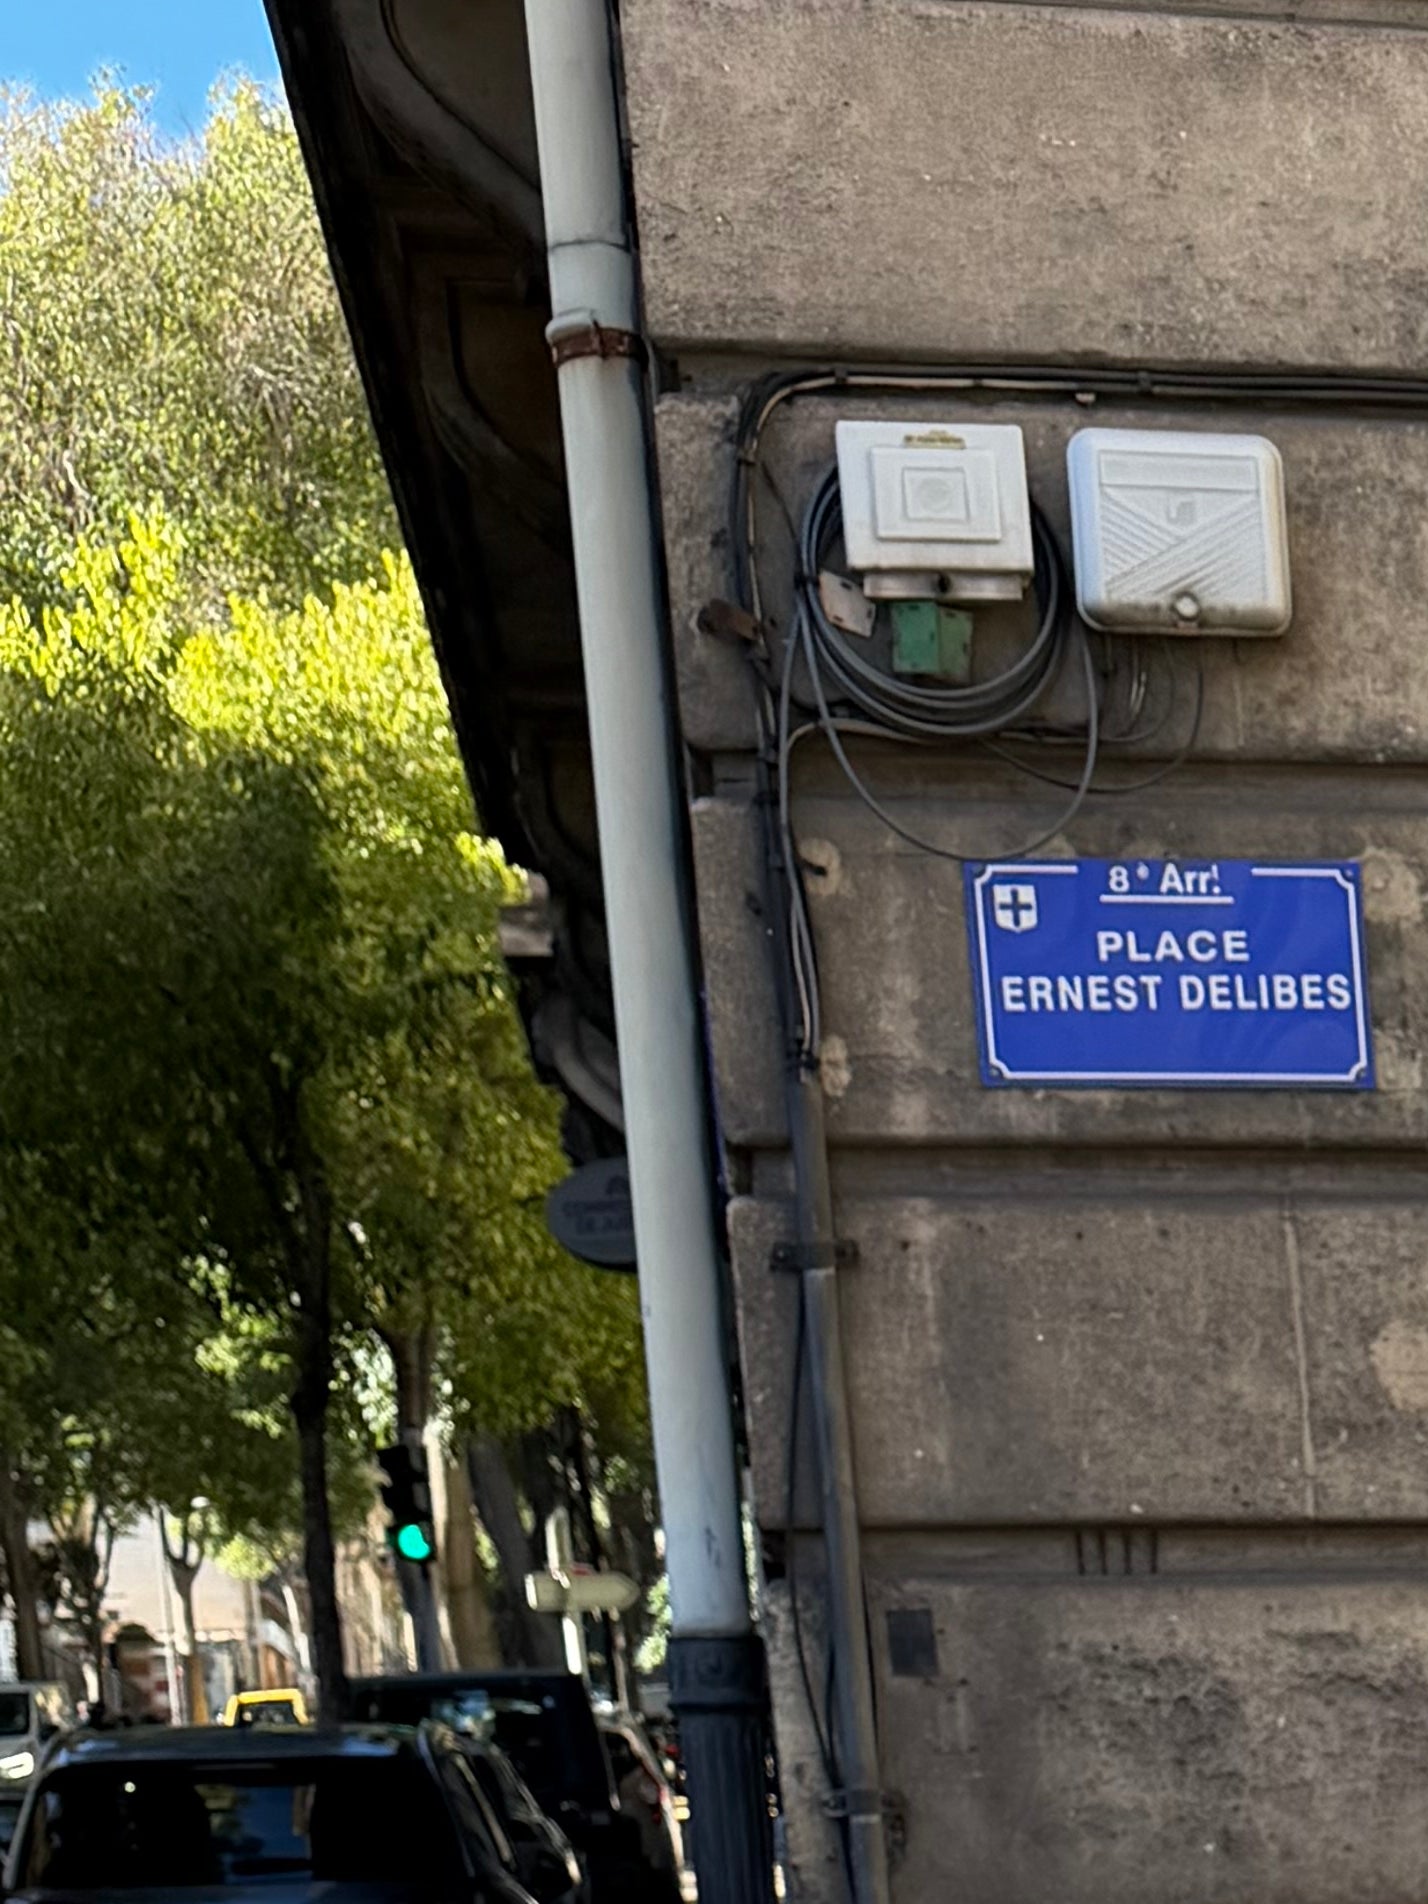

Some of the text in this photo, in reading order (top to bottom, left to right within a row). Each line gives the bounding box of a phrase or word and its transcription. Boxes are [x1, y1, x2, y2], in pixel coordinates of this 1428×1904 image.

[1097, 930, 1251, 962] PLACE
[1001, 973, 1351, 1012] ERNEST DELIBES
